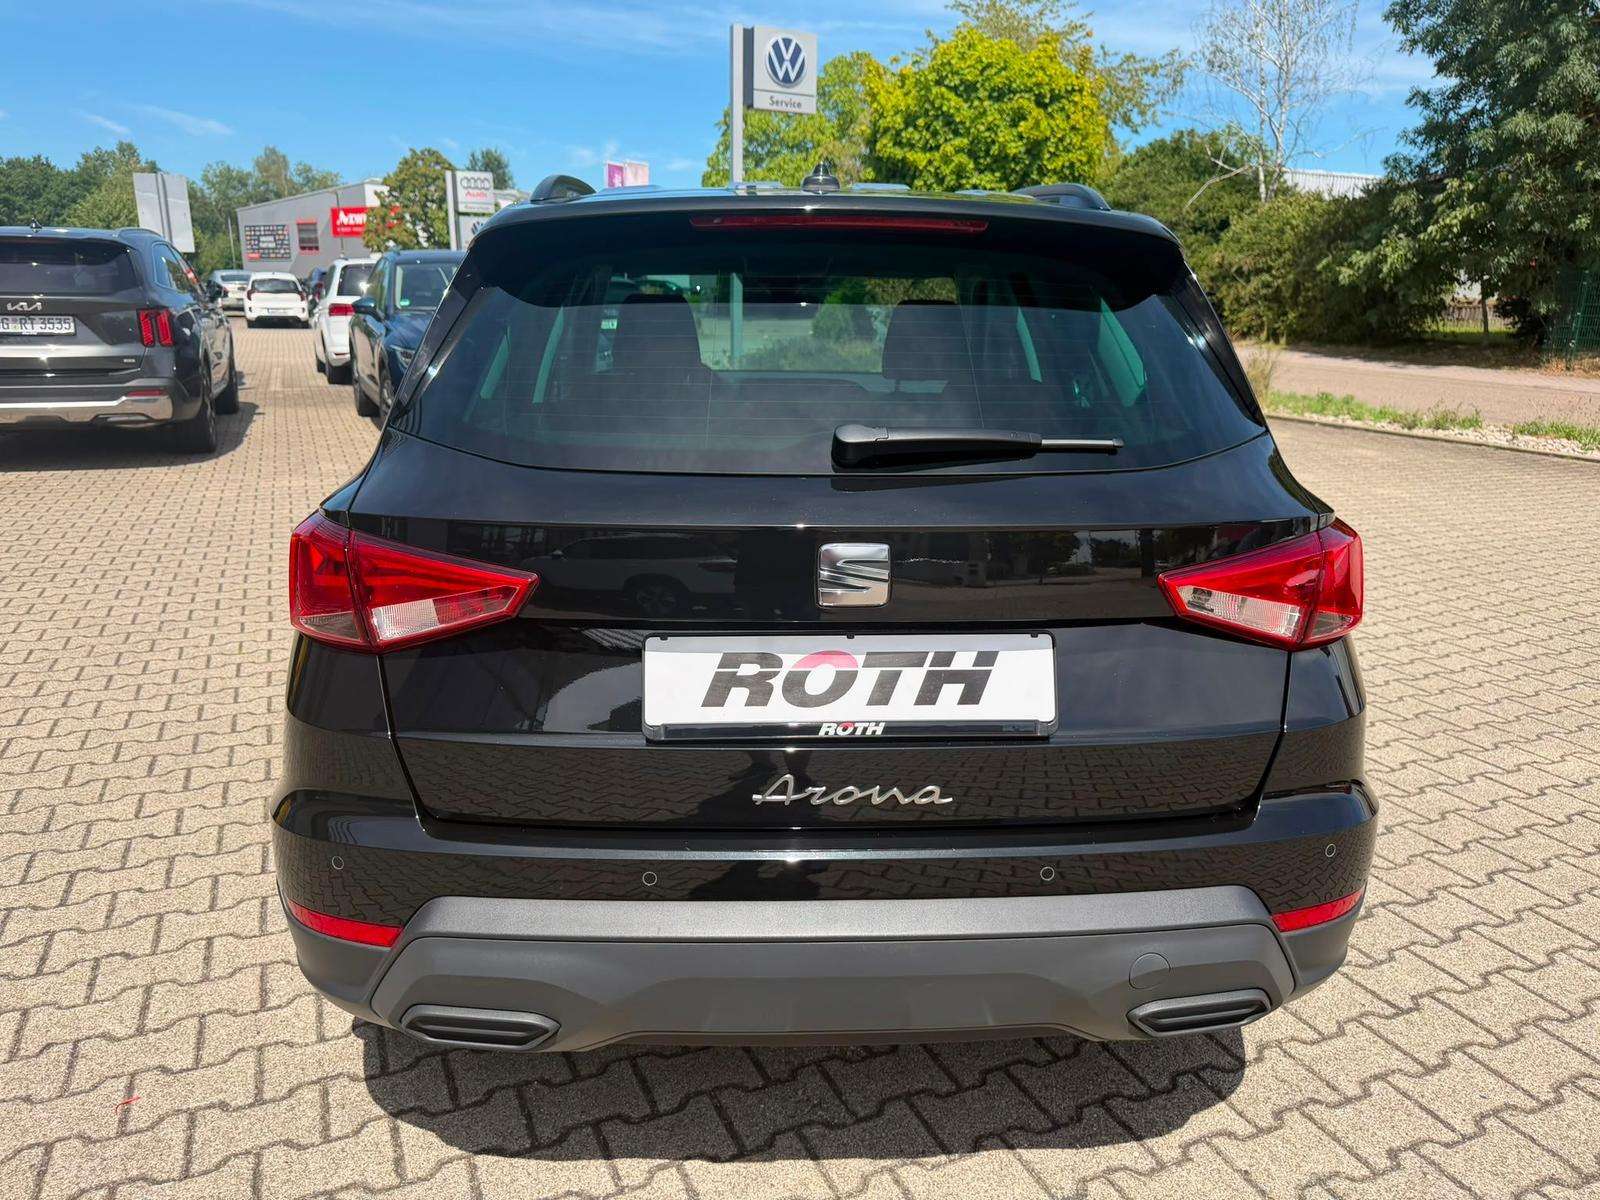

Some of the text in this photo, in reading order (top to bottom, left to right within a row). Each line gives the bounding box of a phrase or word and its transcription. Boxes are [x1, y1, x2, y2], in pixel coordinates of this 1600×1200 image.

[769, 96, 802, 109] Service
[40, 316, 72, 331] 3535
[701, 650, 999, 708] ROTH
[819, 722, 885, 736] ROTH
[752, 774, 953, 805] Arona
